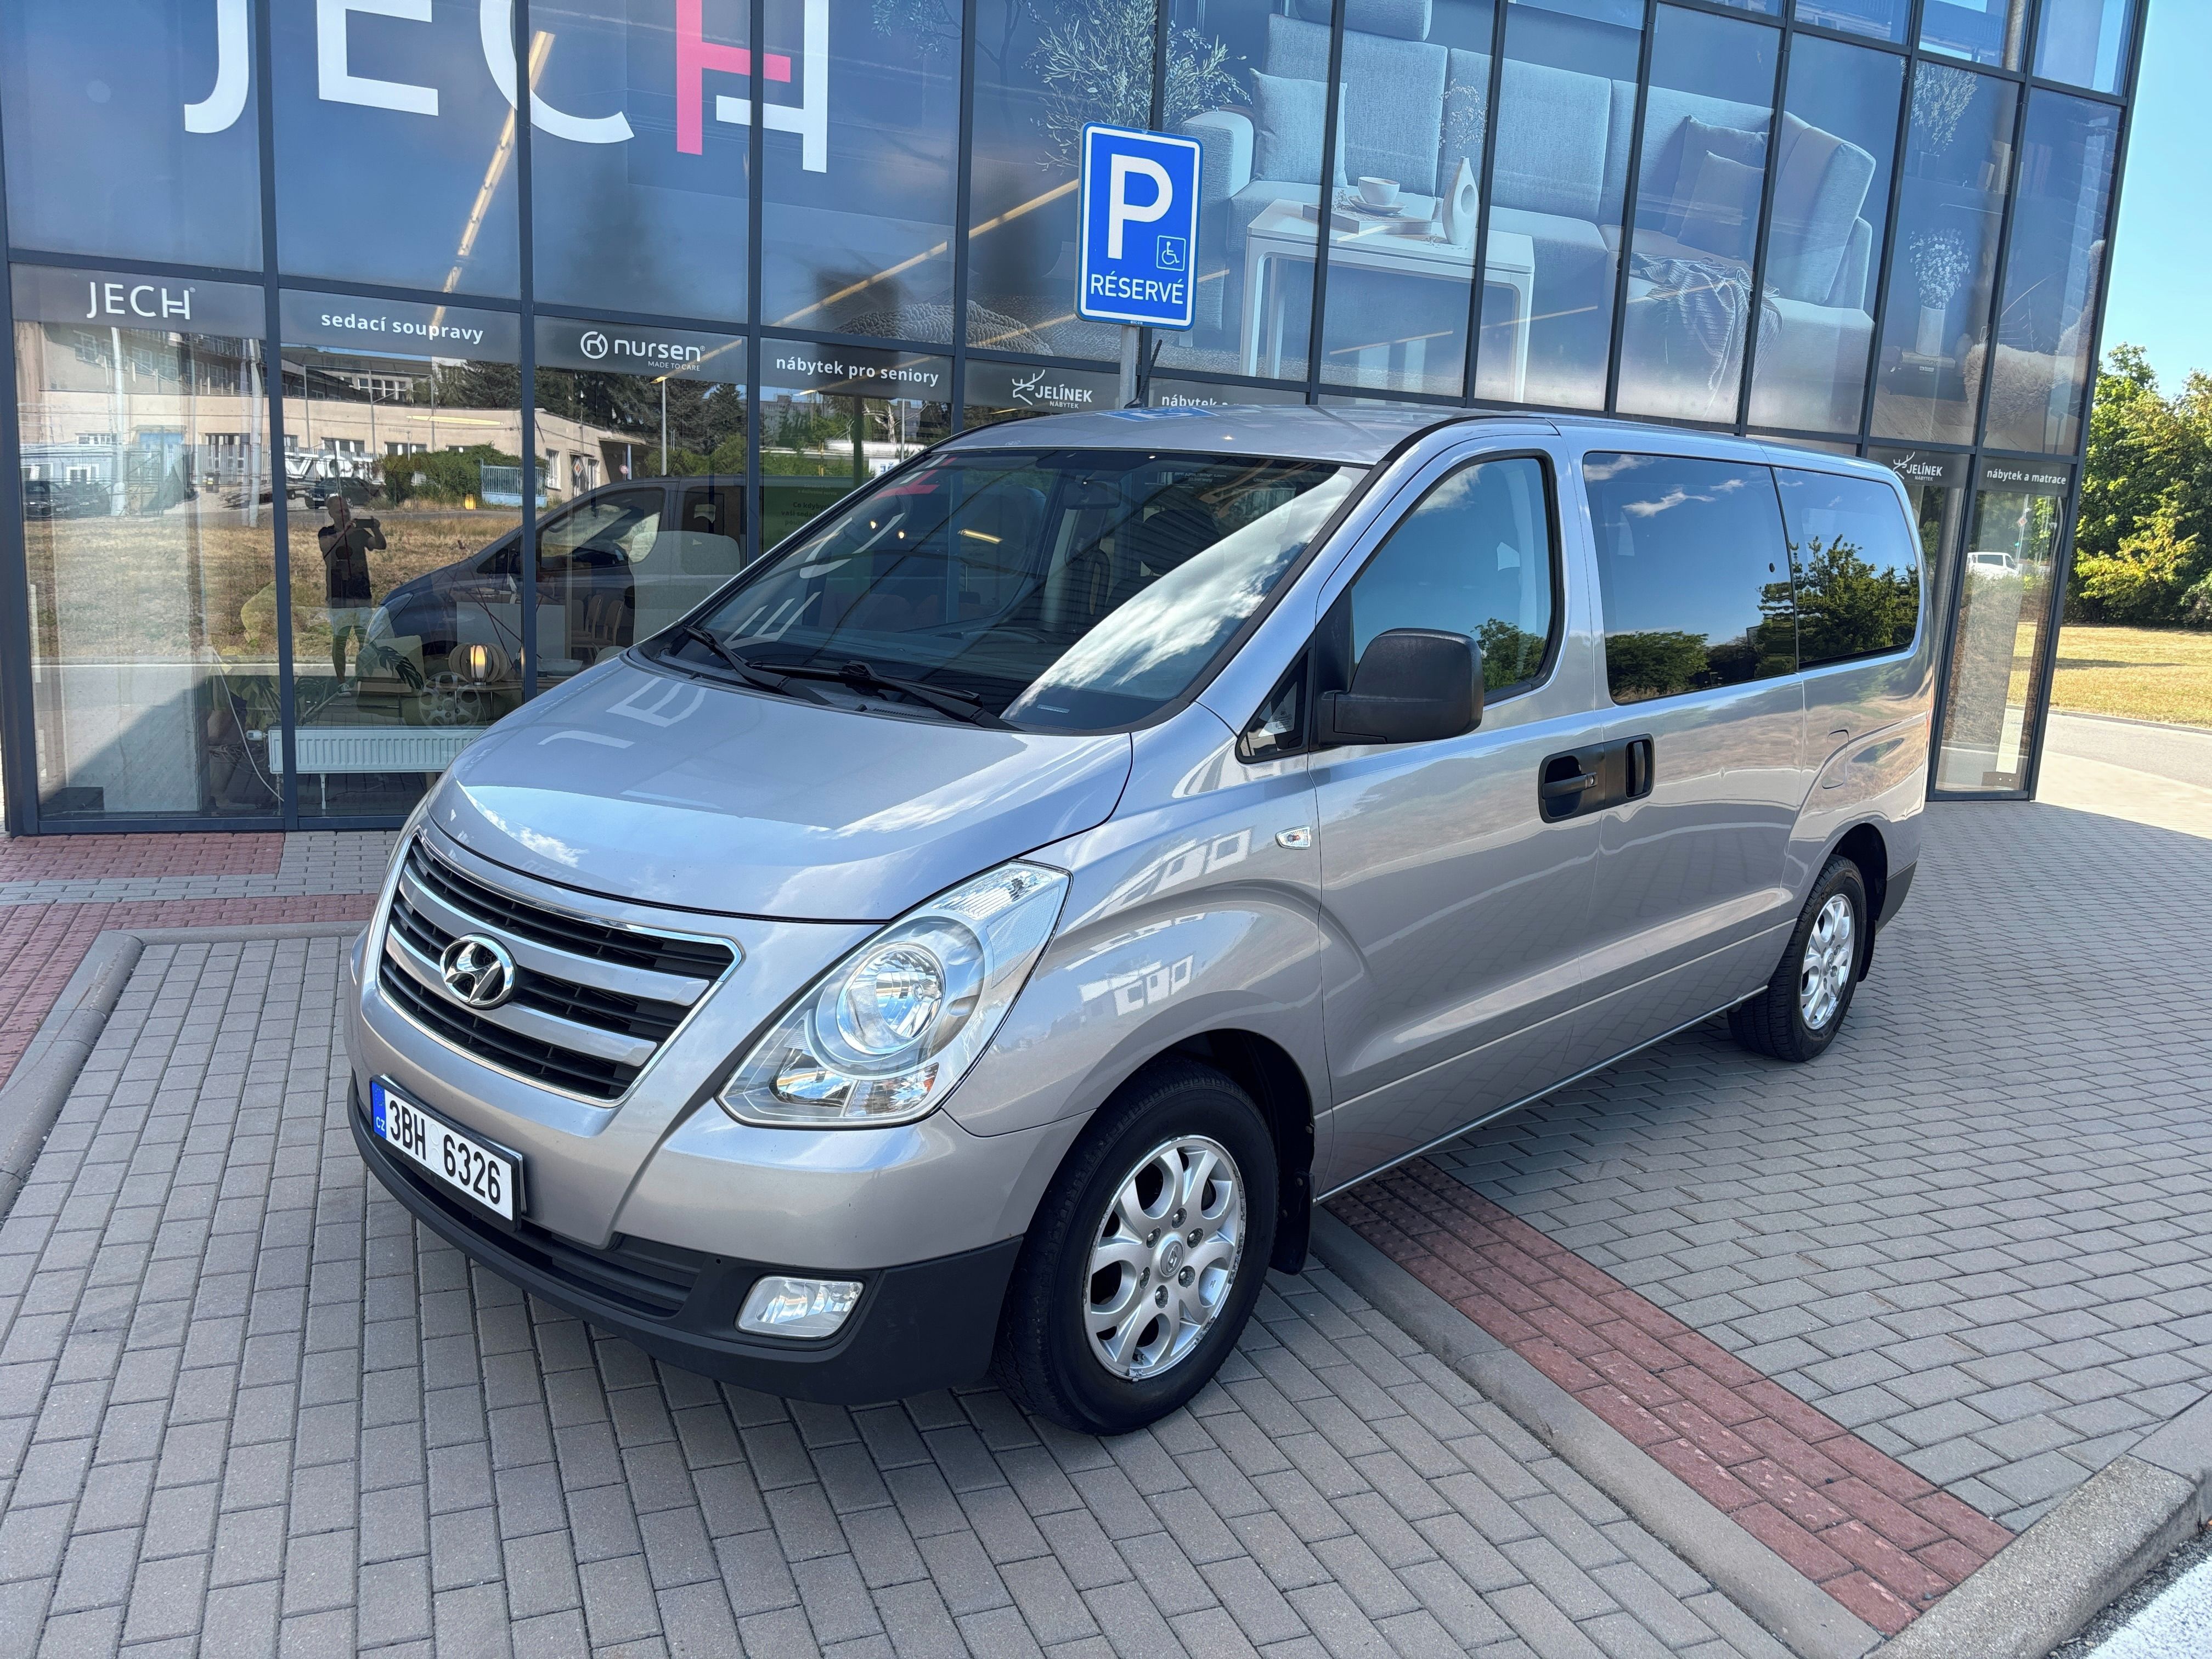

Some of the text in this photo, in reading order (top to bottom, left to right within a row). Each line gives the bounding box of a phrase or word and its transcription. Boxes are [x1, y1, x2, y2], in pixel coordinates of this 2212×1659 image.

[1107, 153, 1173, 260] P
[1090, 270, 1184, 304] RÉSERVÉ
[86, 281, 190, 320] JECH
[321, 313, 483, 345] sedací soupravy
[614, 339, 701, 362] nursen
[648, 360, 669, 369] MADE
[776, 356, 939, 387] nábytek pro seniory
[1035, 383, 1093, 403] JELÍNEK
[1049, 400, 1079, 409] NÁBYTEK
[1906, 462, 1943, 477] JELÍNEK
[1987, 469, 2023, 482] nábytek
[2032, 474, 2067, 485] matrace
[376, 1116, 386, 1132] CZ
[390, 1099, 501, 1205] 3BH 6326
